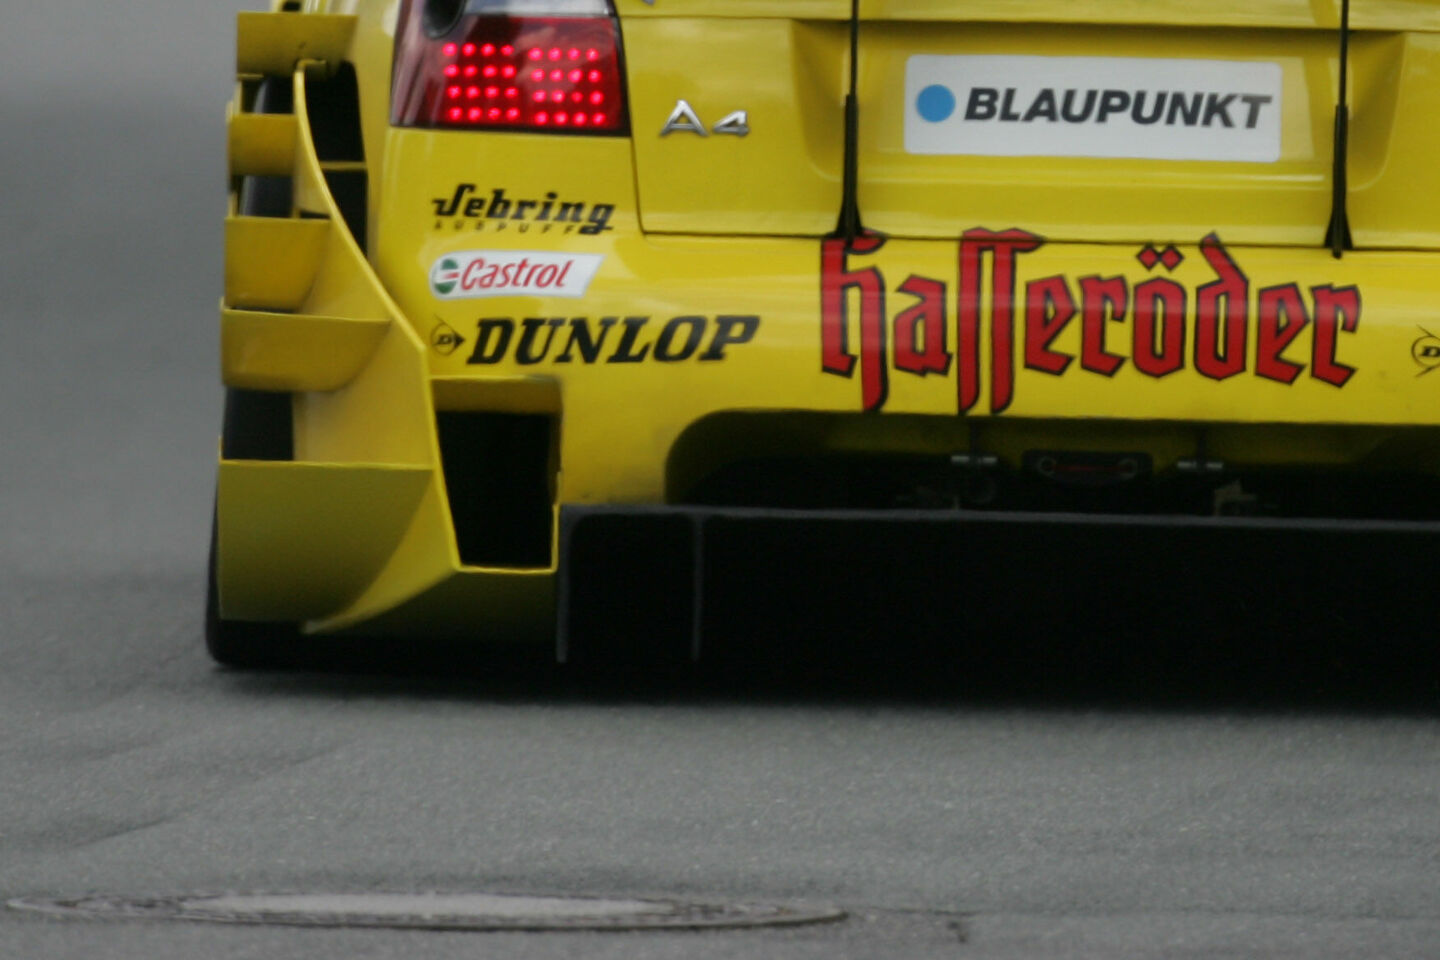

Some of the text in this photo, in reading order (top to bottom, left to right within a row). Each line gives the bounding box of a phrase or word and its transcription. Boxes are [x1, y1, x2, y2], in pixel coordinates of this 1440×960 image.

[660, 99, 749, 137] A4
[964, 87, 1272, 129] BLAUPUNKT
[432, 183, 615, 235] Sebring
[461, 257, 573, 290] Castrol
[466, 315, 760, 366] DUNLOP
